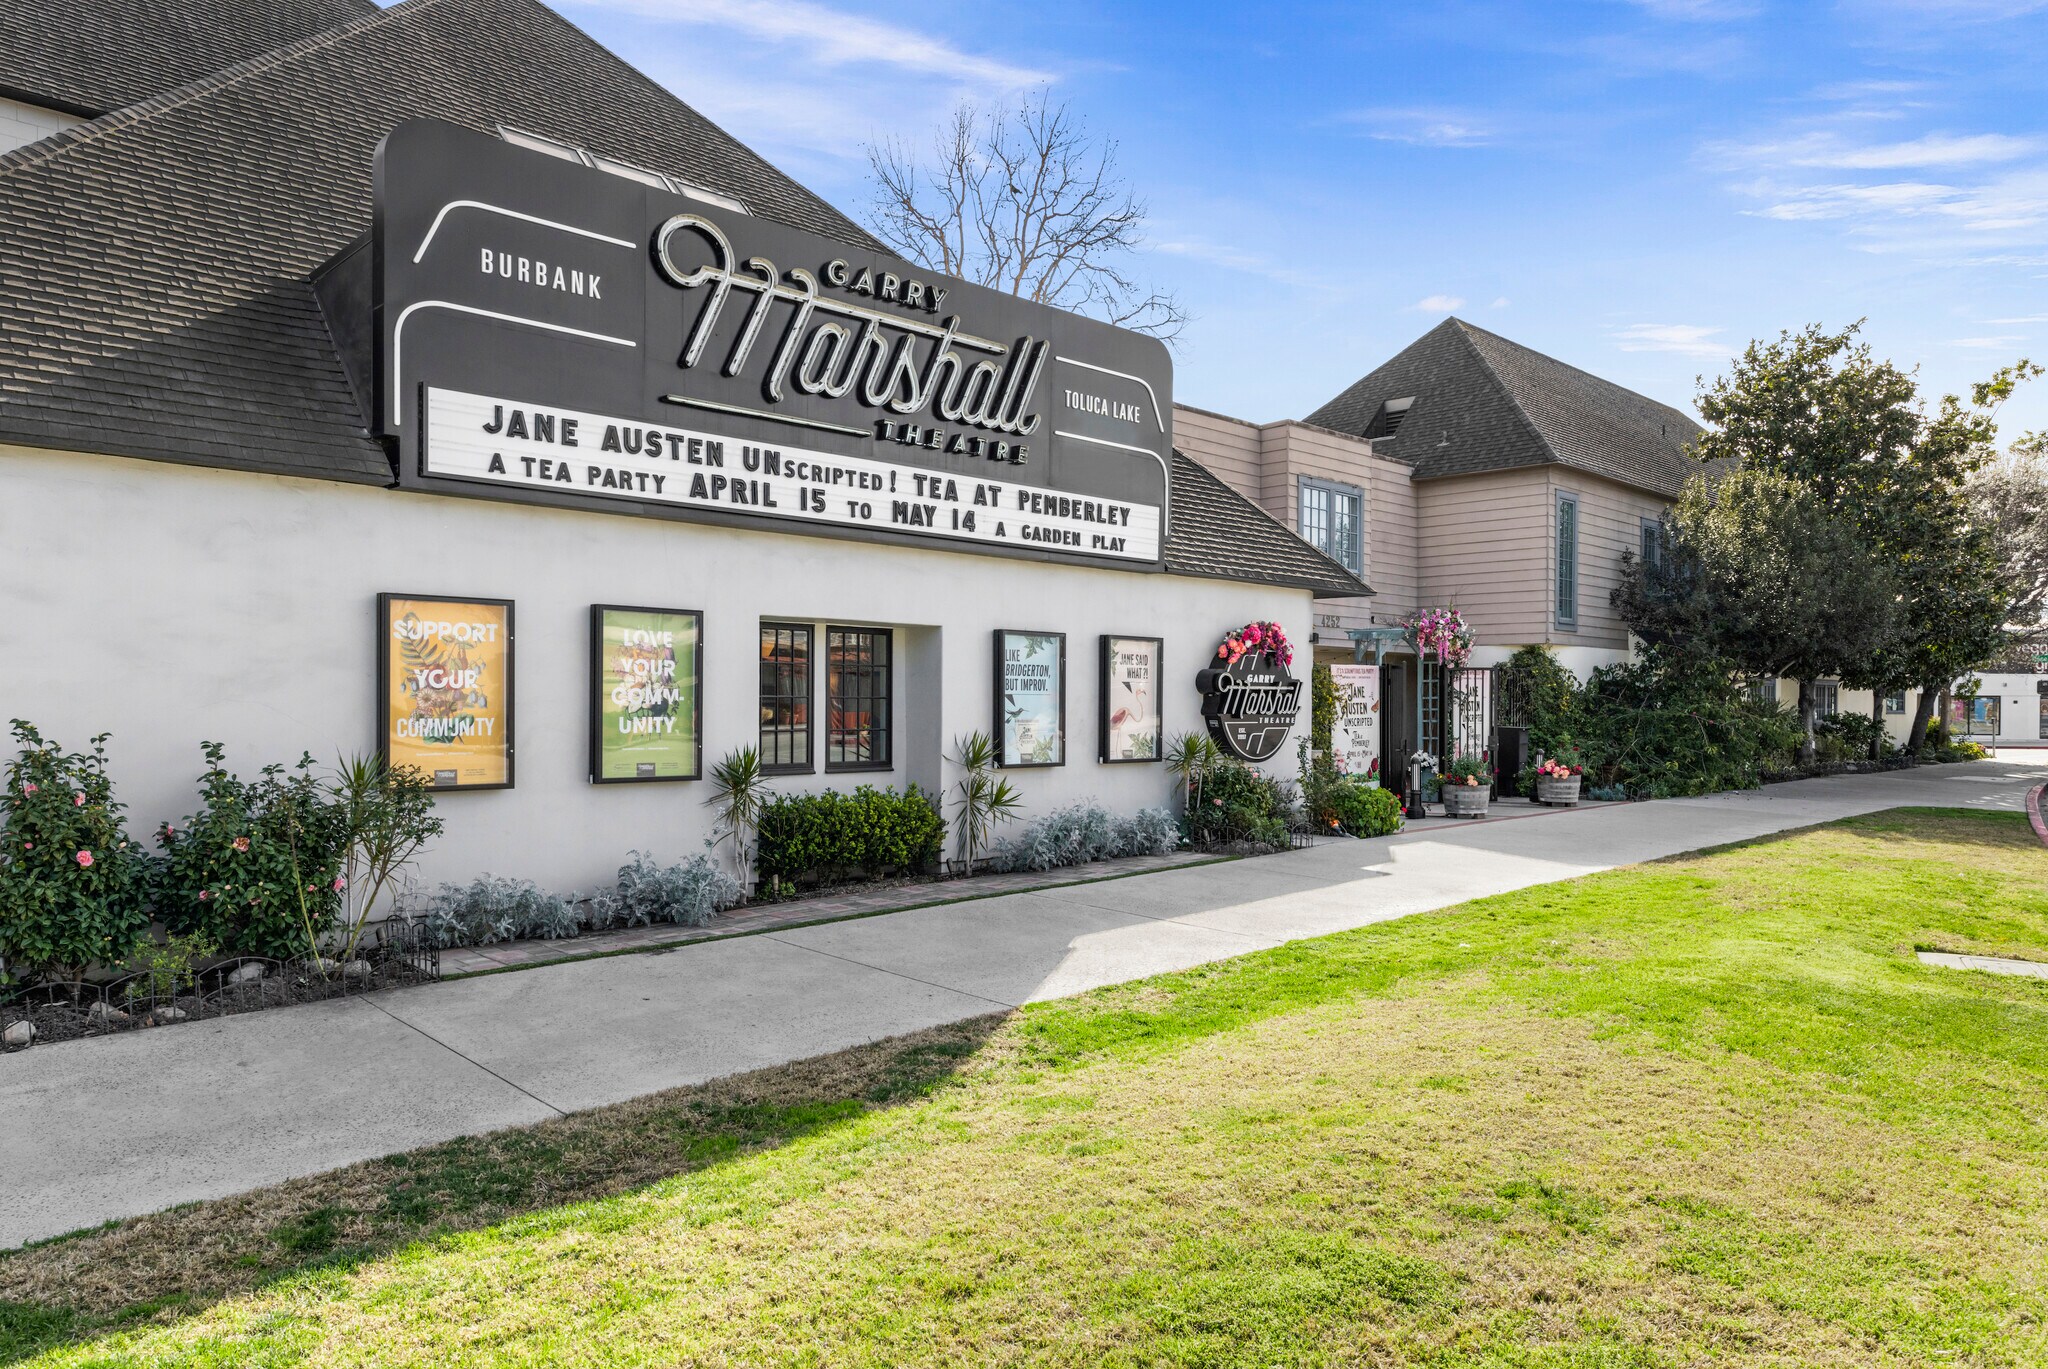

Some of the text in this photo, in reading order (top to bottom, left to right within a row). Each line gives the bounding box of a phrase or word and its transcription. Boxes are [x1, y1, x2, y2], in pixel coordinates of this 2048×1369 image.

[481, 247, 601, 299] BURBANK
[828, 258, 950, 313] GARRY
[655, 213, 1050, 437] Marshall
[1065, 389, 1141, 424] TOLUCA LAKE
[877, 419, 1030, 466] THEATRE
[482, 404, 578, 447] JANE
[601, 424, 724, 467] AUSTEN
[913, 472, 959, 502] TEA
[974, 483, 1002, 507] AT
[1018, 489, 1131, 527] PEMBERLEY
[488, 452, 1127, 552] A TEA PARTY APRIL 15 TO MAY 14 A GARDEN PLAY
[393, 619, 498, 642] SUPPORT
[1321, 615, 1340, 628] 4252
[623, 629, 673, 648] LOVE
[1005, 649, 1020, 662] LIKE
[1119, 653, 1148, 666] JANE SAID
[620, 658, 676, 677] YOUR
[1005, 664, 1051, 678] BRIDGERTON,
[1127, 667, 1141, 679] WHAT
[414, 669, 479, 690] YOUR
[1005, 679, 1048, 692] BUT IMPROV.
[1246, 674, 1275, 683] GARRY
[1347, 683, 1365, 701] JANE
[1341, 700, 1368, 720] AUSTEN
[396, 717, 495, 738] COMMUNITY
[618, 716, 676, 734] UNITY
[1343, 717, 1374, 727] UNSCRIPTED
